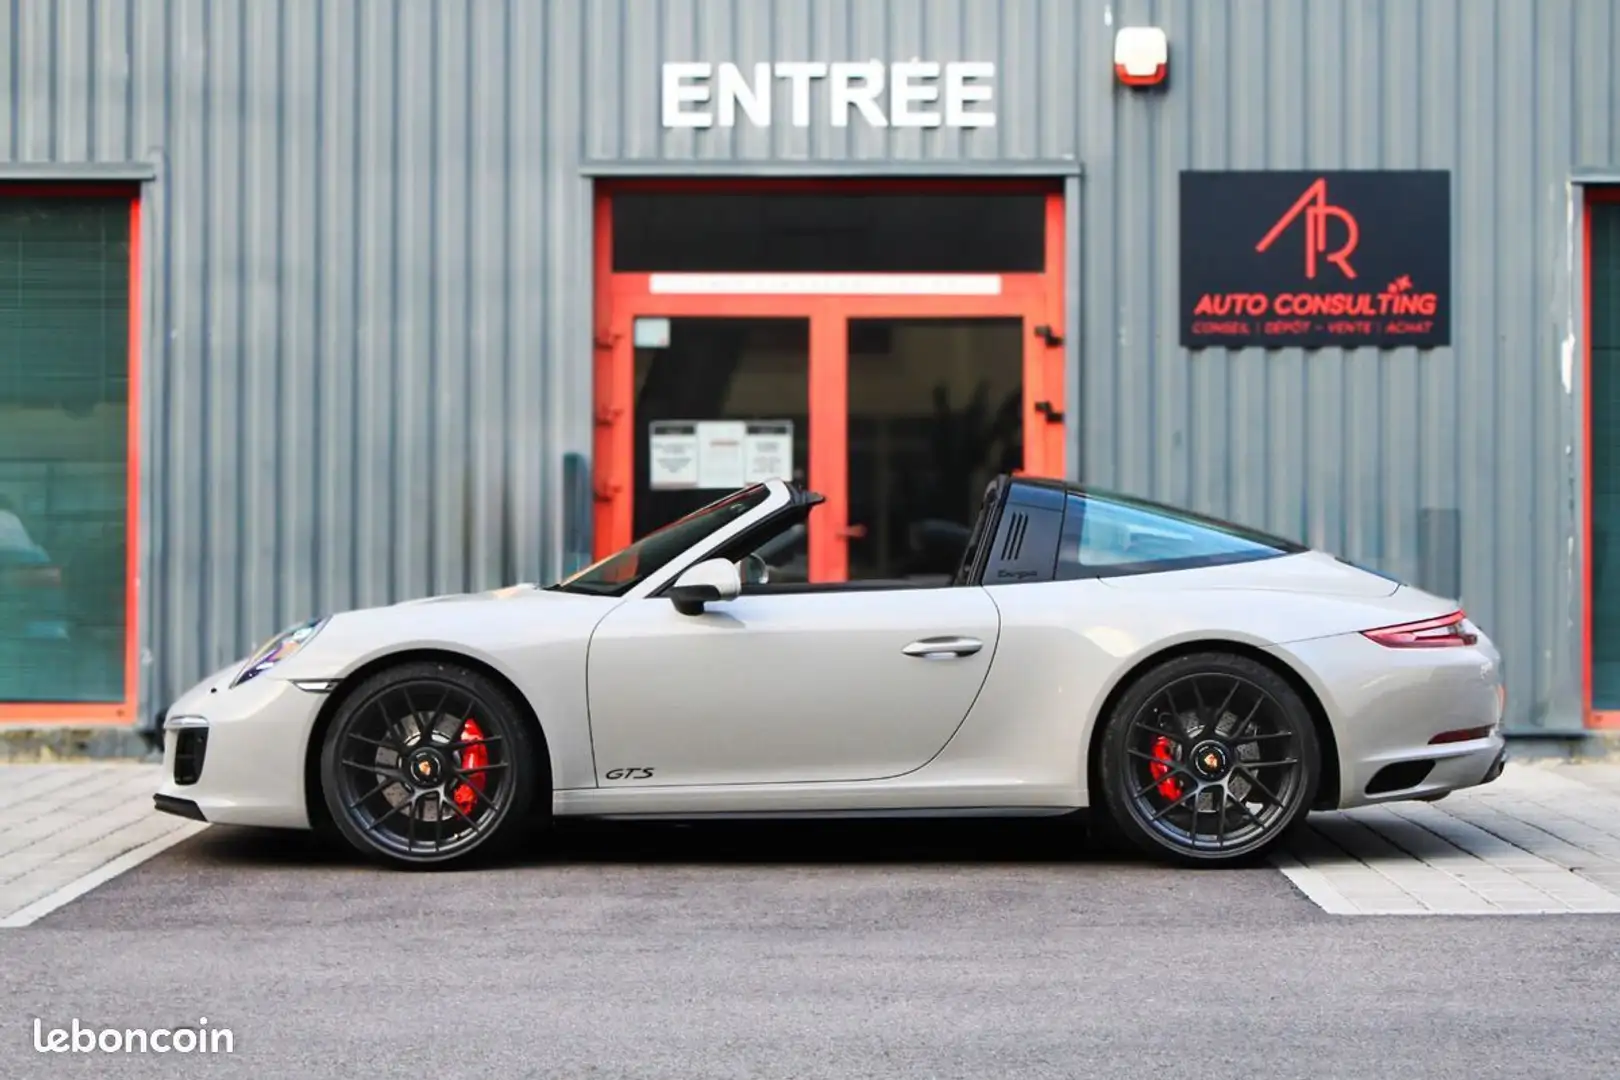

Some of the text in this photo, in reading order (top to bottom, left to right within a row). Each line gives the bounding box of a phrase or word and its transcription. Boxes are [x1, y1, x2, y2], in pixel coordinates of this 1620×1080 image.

[1193, 293, 1437, 316] AUTO CONSULTING
[605, 767, 655, 780] GTS
